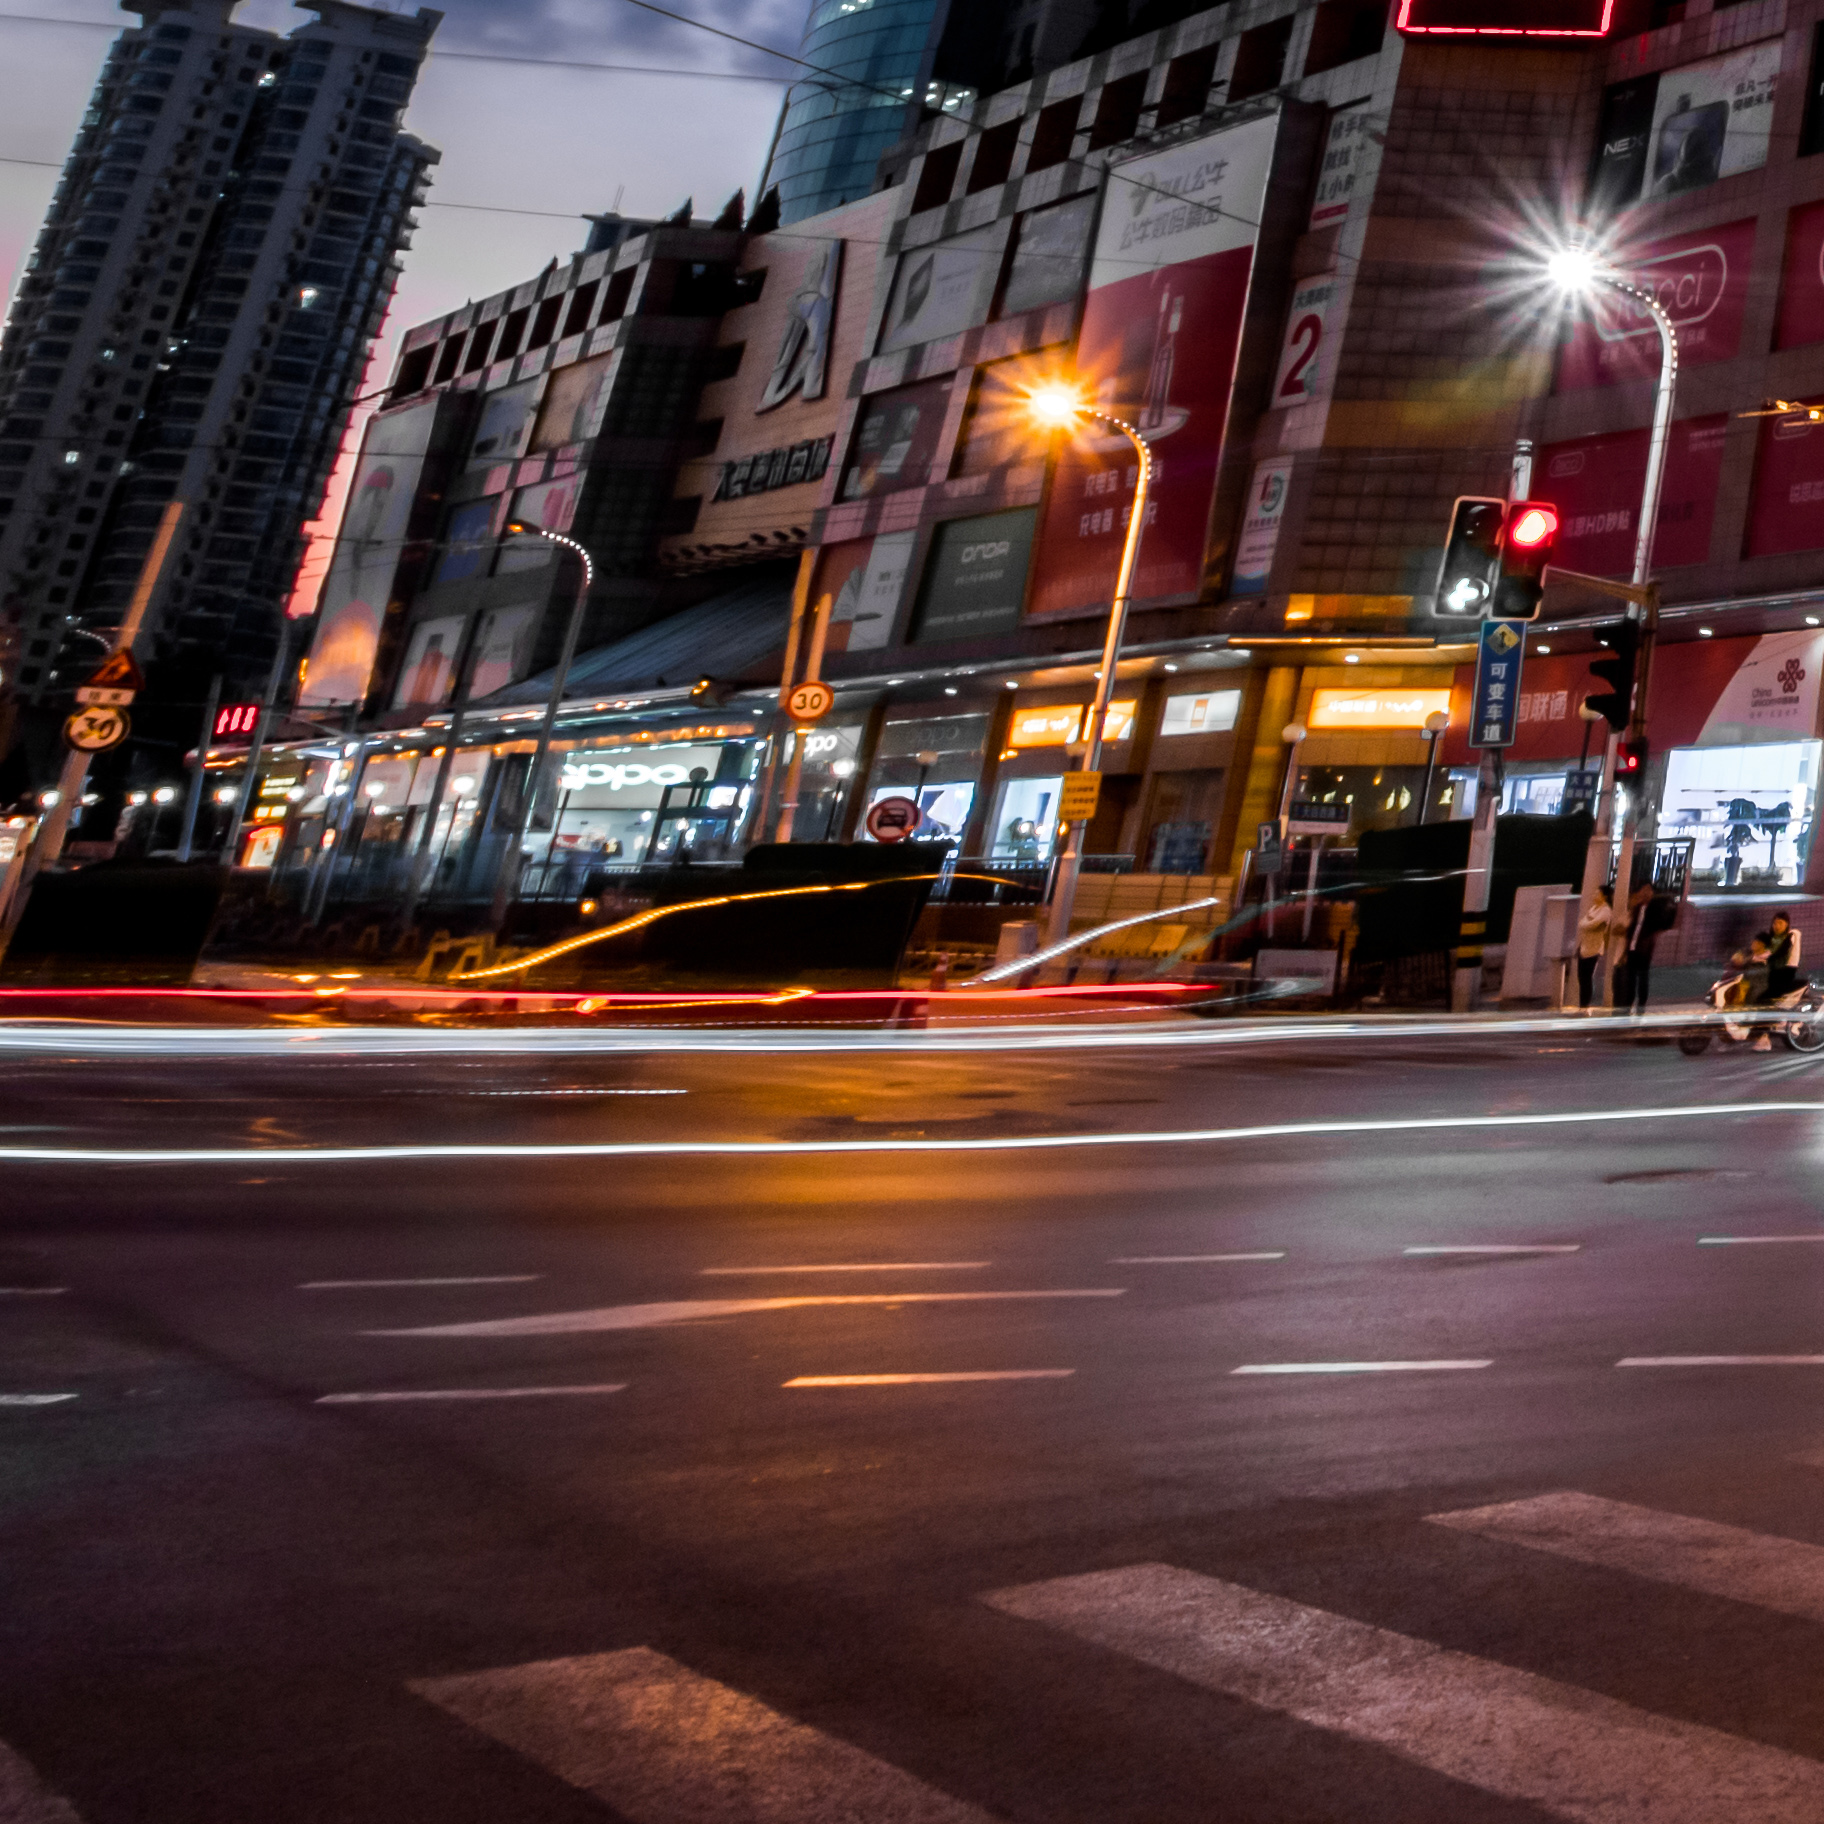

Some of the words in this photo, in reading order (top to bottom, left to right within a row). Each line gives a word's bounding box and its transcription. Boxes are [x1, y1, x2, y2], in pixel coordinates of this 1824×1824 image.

[1279, 313, 1323, 398] 2
[794, 692, 823, 711] 30
[1482, 662, 1508, 742] 可变车道
[1257, 826, 1274, 853] P
